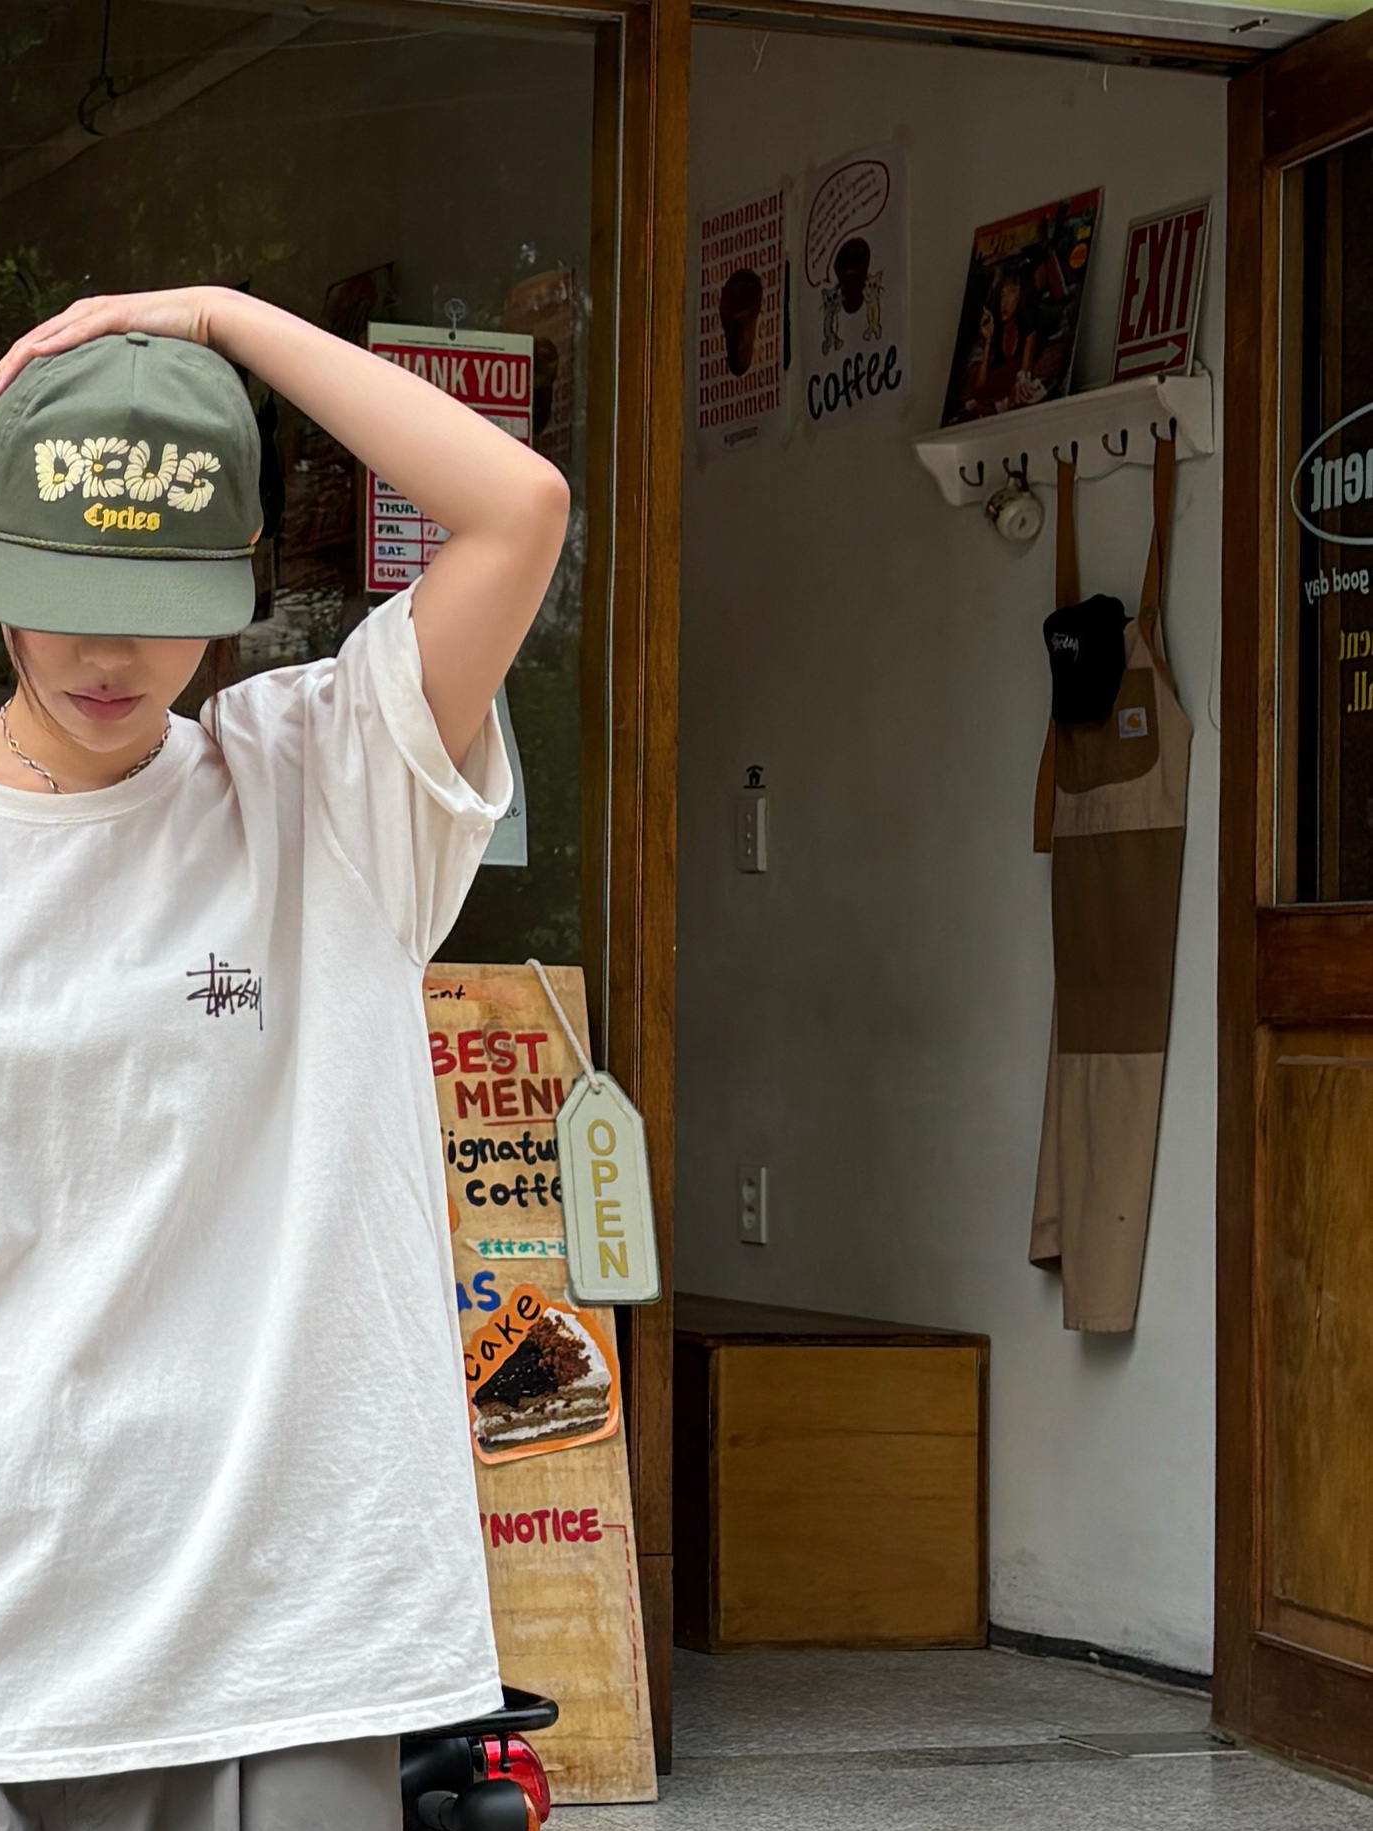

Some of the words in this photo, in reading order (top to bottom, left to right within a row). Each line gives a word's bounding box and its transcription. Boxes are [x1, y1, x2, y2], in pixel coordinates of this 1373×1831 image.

[702, 190, 783, 239] nomoment
[702, 216, 782, 264] nomoment
[1117, 209, 1205, 345] EXIT
[472, 358, 528, 400] YOU
[700, 386, 781, 429] nomoment
[34, 437, 221, 513] DEUS
[429, 1028, 548, 1077] BEST
[587, 1118, 629, 1278] OPEN
[489, 1507, 603, 1549] NOTICE
